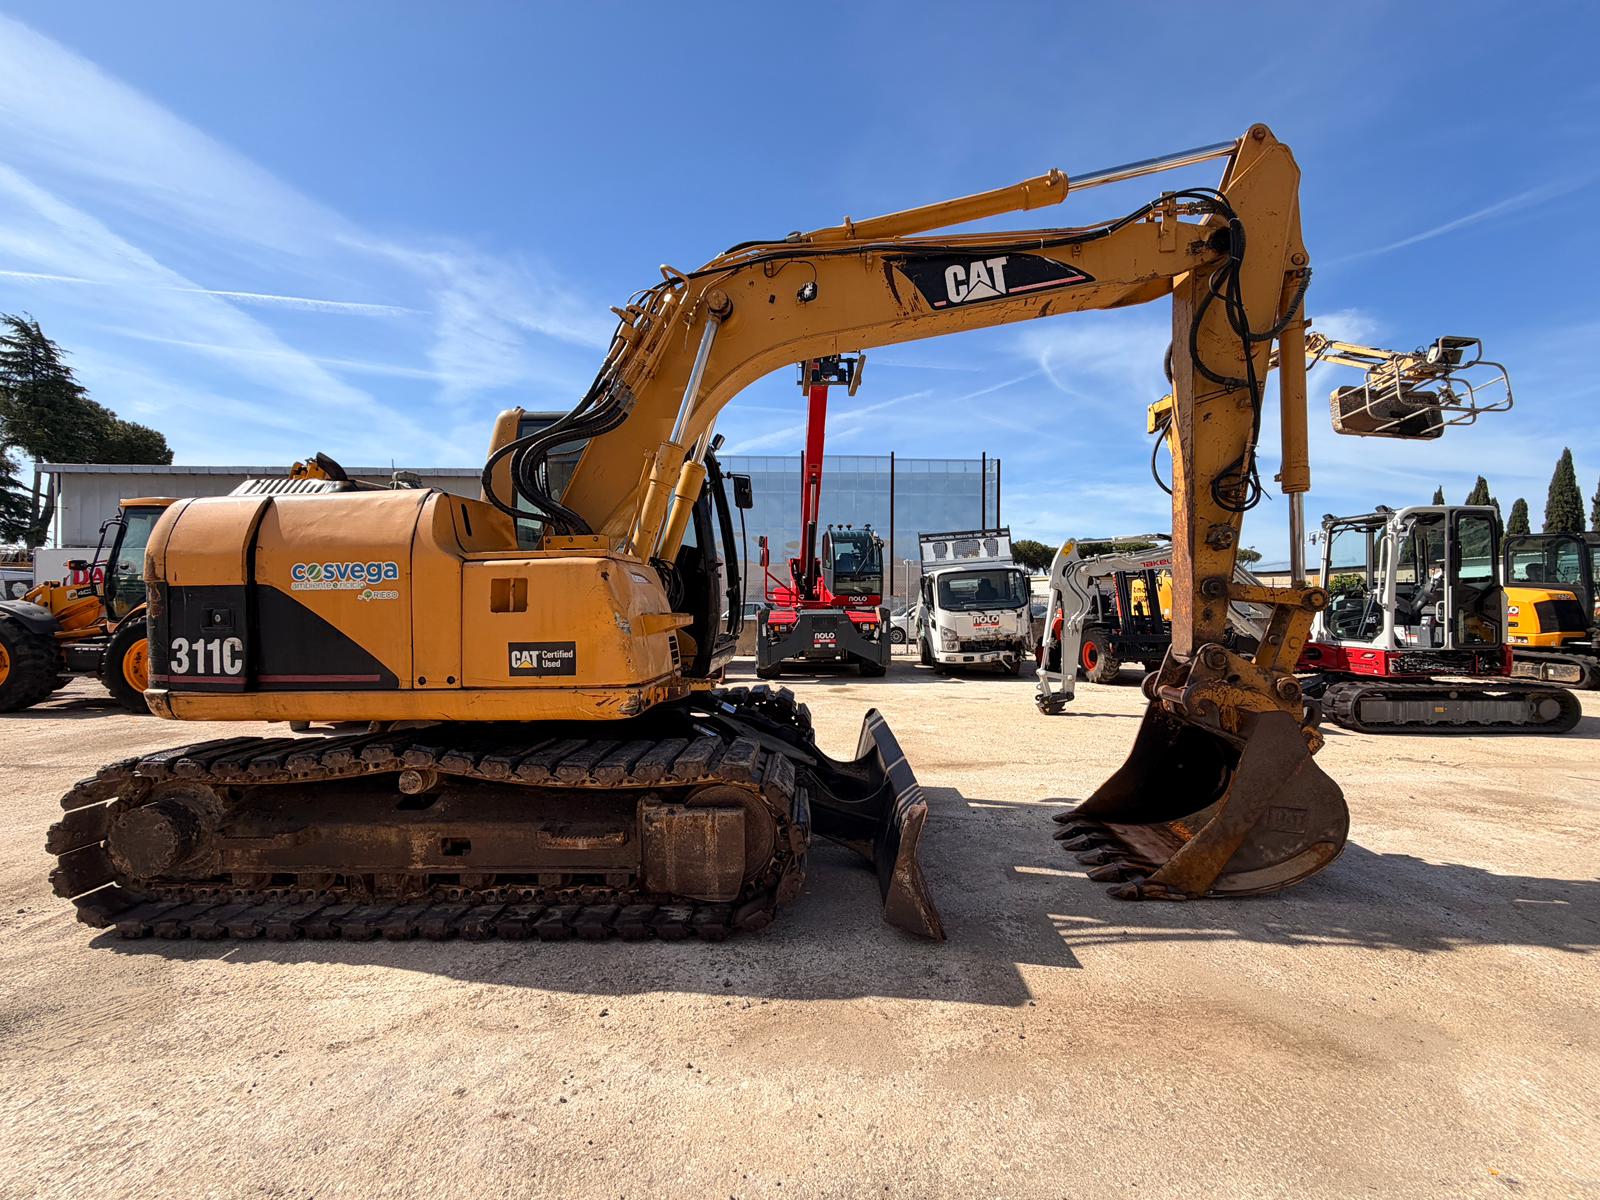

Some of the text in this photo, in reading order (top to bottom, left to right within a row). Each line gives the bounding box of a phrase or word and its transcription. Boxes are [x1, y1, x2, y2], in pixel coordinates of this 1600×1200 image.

[944, 255, 1008, 303] CAT
[291, 562, 399, 584] cosvega
[292, 581, 331, 590] ambiente
[373, 591, 398, 599] RIECO
[170, 637, 243, 675] 311C
[511, 649, 574, 669] CAT Certified
[542, 659, 561, 668] Used
